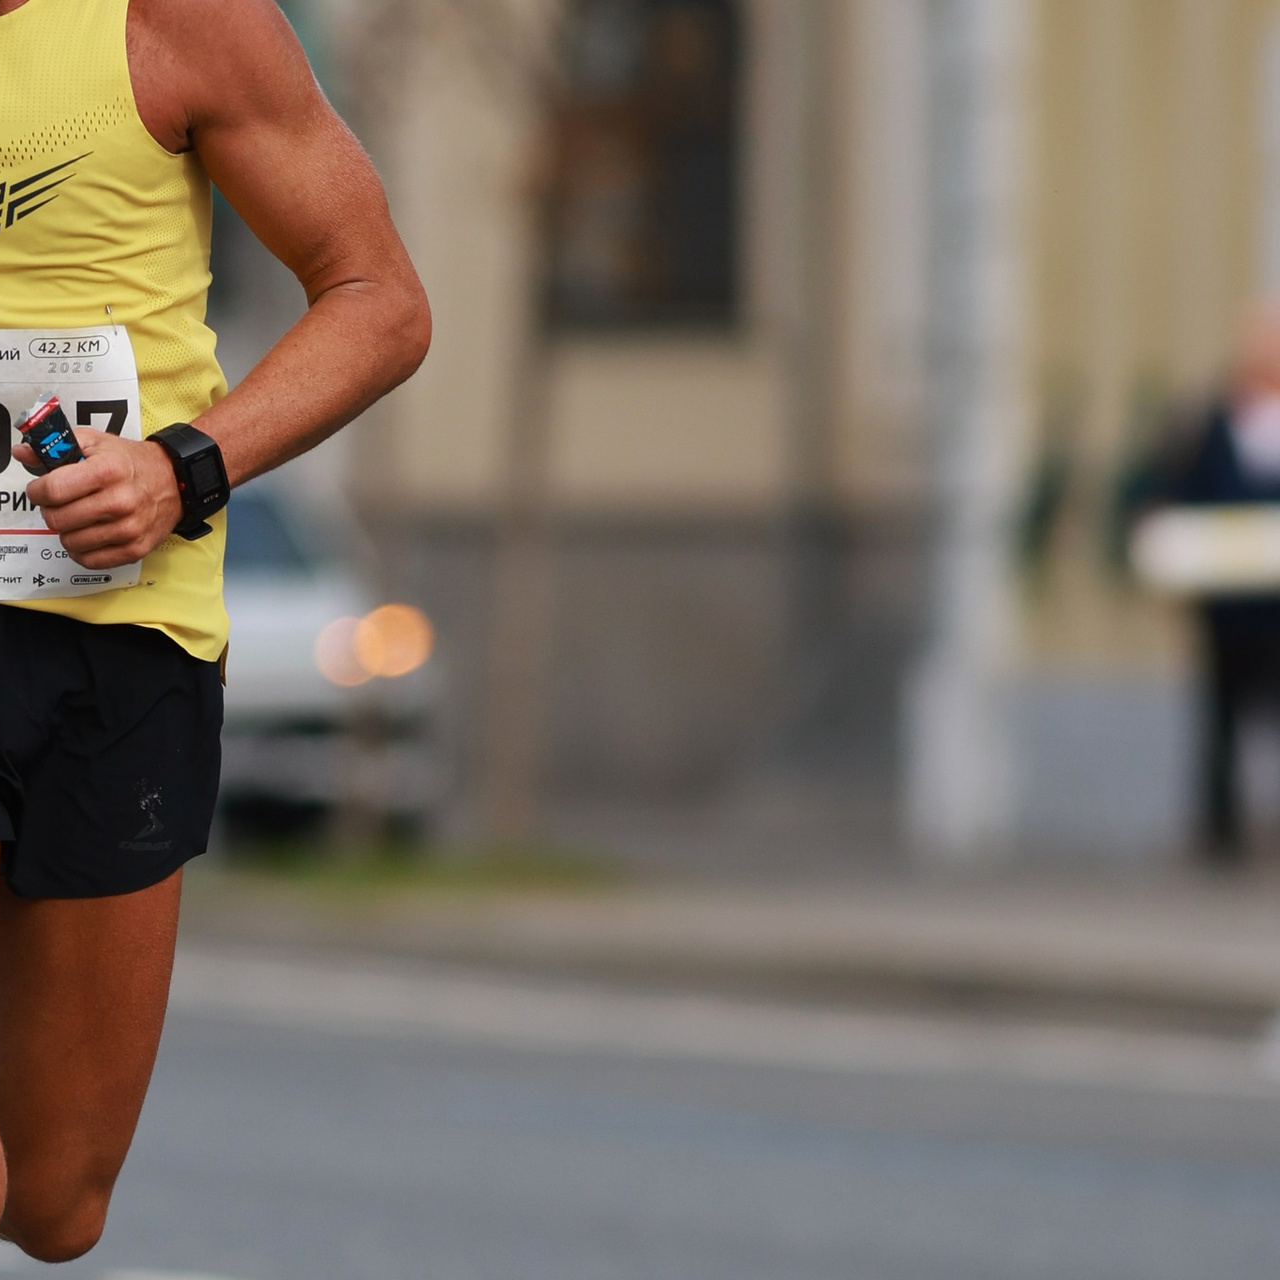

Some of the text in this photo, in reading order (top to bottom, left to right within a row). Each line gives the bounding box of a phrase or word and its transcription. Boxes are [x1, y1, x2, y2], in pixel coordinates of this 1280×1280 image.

[38, 340, 100, 355] 42,2 КМ
[48, 361, 93, 374] 2026
